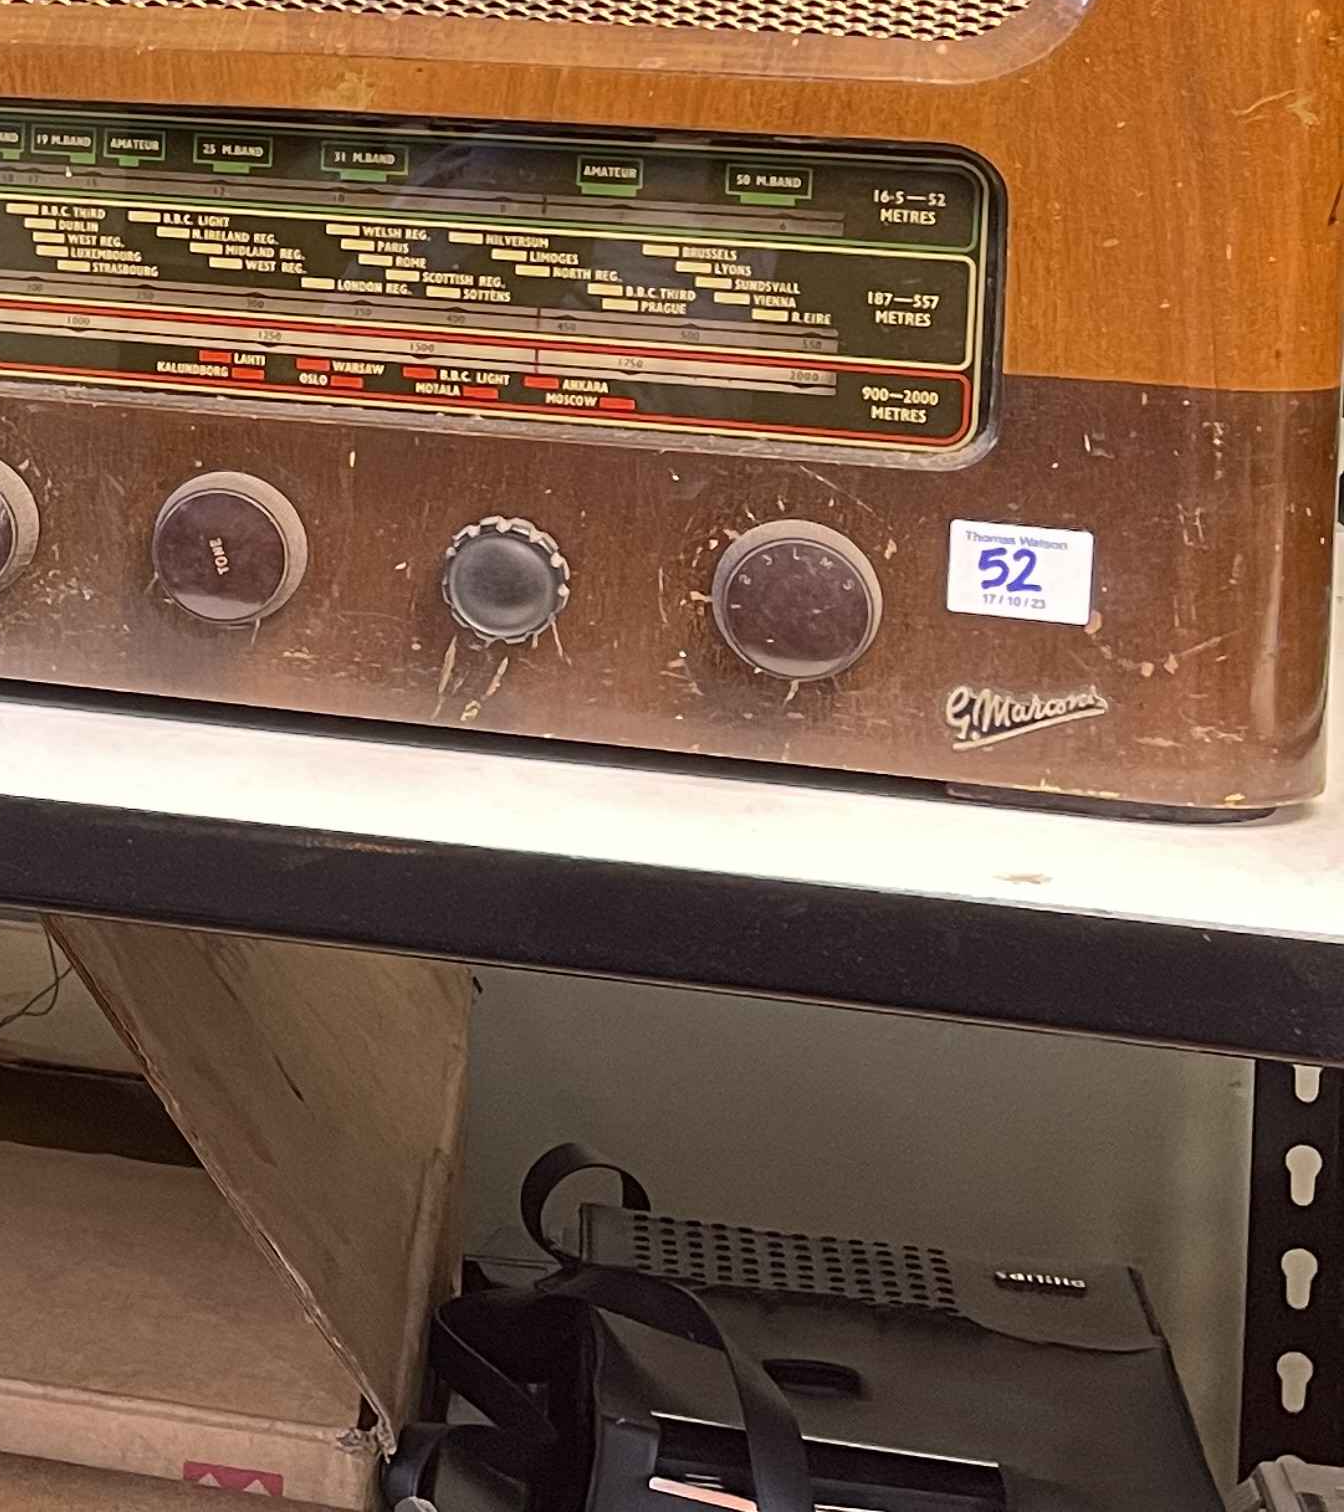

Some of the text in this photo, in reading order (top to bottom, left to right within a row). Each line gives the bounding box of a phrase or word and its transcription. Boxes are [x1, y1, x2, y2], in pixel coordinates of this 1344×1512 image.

[37, 134, 91, 148] 19 M.BAND
[110, 137, 160, 152] AMATEUR
[222, 145, 263, 158] M.BAND
[334, 151, 396, 166] 31 M.BAND
[583, 164, 637, 179] AMATEUR
[756, 175, 802, 189] M.BAND
[73, 206, 106, 220] THIRD
[198, 214, 230, 227] LIGHT
[880, 208, 937, 225] METRES
[58, 219, 99, 233] DUBLIN
[362, 225, 430, 241] WELSH REG.
[67, 233, 125, 248] WEST REG.
[253, 232, 280, 246] REG.
[485, 233, 549, 248] HILVERSUM
[70, 246, 142, 262] LUXEMBOURG
[224, 244, 306, 261] MIDLAND REG.
[377, 240, 409, 254] PARIS
[681, 246, 738, 261] BRUSSELS
[395, 256, 427, 269] ROME
[529, 251, 579, 266] LIMOGES
[92, 262, 159, 277] STRASBOURG
[245, 259, 308, 275] WEST REG.
[553, 266, 623, 282] NORTH REG.
[714, 262, 752, 276] LYONS
[337, 279, 413, 295] LONDON REG.
[422, 271, 506, 289] SCOTTISH REG.
[734, 278, 800, 295] SUNDSVALL
[463, 288, 511, 303] SOTTENS
[753, 293, 797, 309] VIENNA
[640, 301, 687, 315] PRAGUE
[875, 310, 932, 327] METRES
[233, 352, 266, 366] LAHTI
[156, 361, 229, 377] KALUNDBORG
[332, 360, 385, 375] WARSAW
[299, 373, 328, 386] OSLO
[475, 371, 510, 386] LIGHT
[562, 378, 609, 394] ANKARA
[415, 382, 461, 397] MOTALA
[545, 392, 598, 407] MOSCOW
[871, 405, 928, 424] METRES
[965, 530, 1016, 545] Thomas
[208, 538, 232, 576] TONE
[977, 547, 1043, 592] 52
